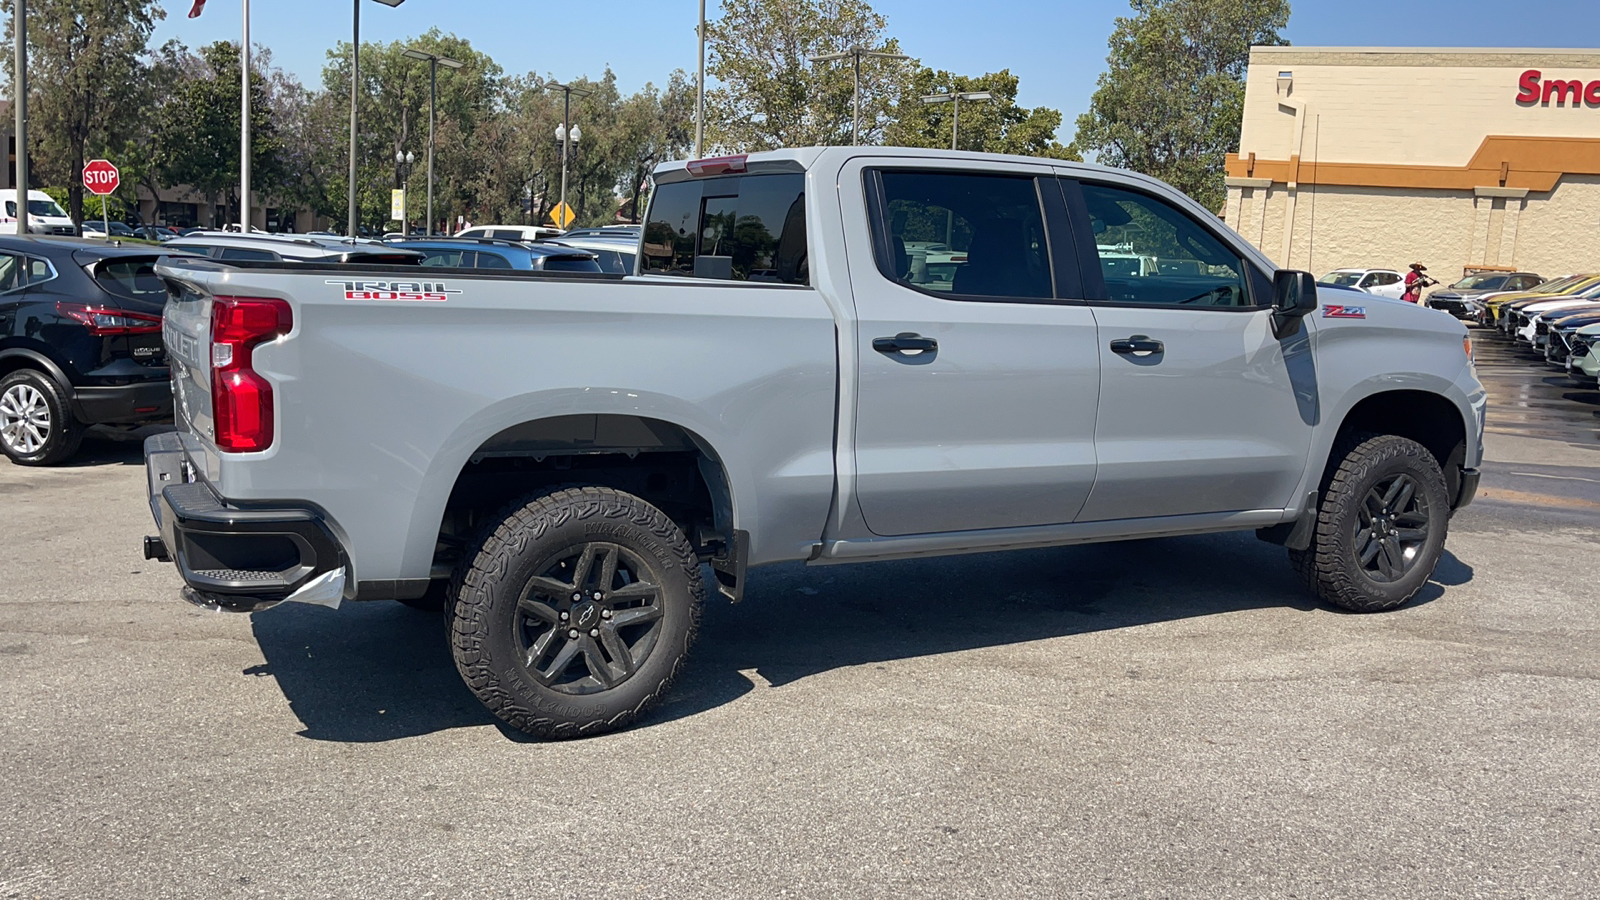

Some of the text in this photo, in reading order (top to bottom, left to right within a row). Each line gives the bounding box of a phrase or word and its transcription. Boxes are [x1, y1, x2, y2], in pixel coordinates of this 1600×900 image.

[85, 170, 116, 184] STOP
[325, 280, 463, 293] TRAIL
[345, 290, 447, 301] BOSS
[585, 522, 674, 570] WRANGLER
